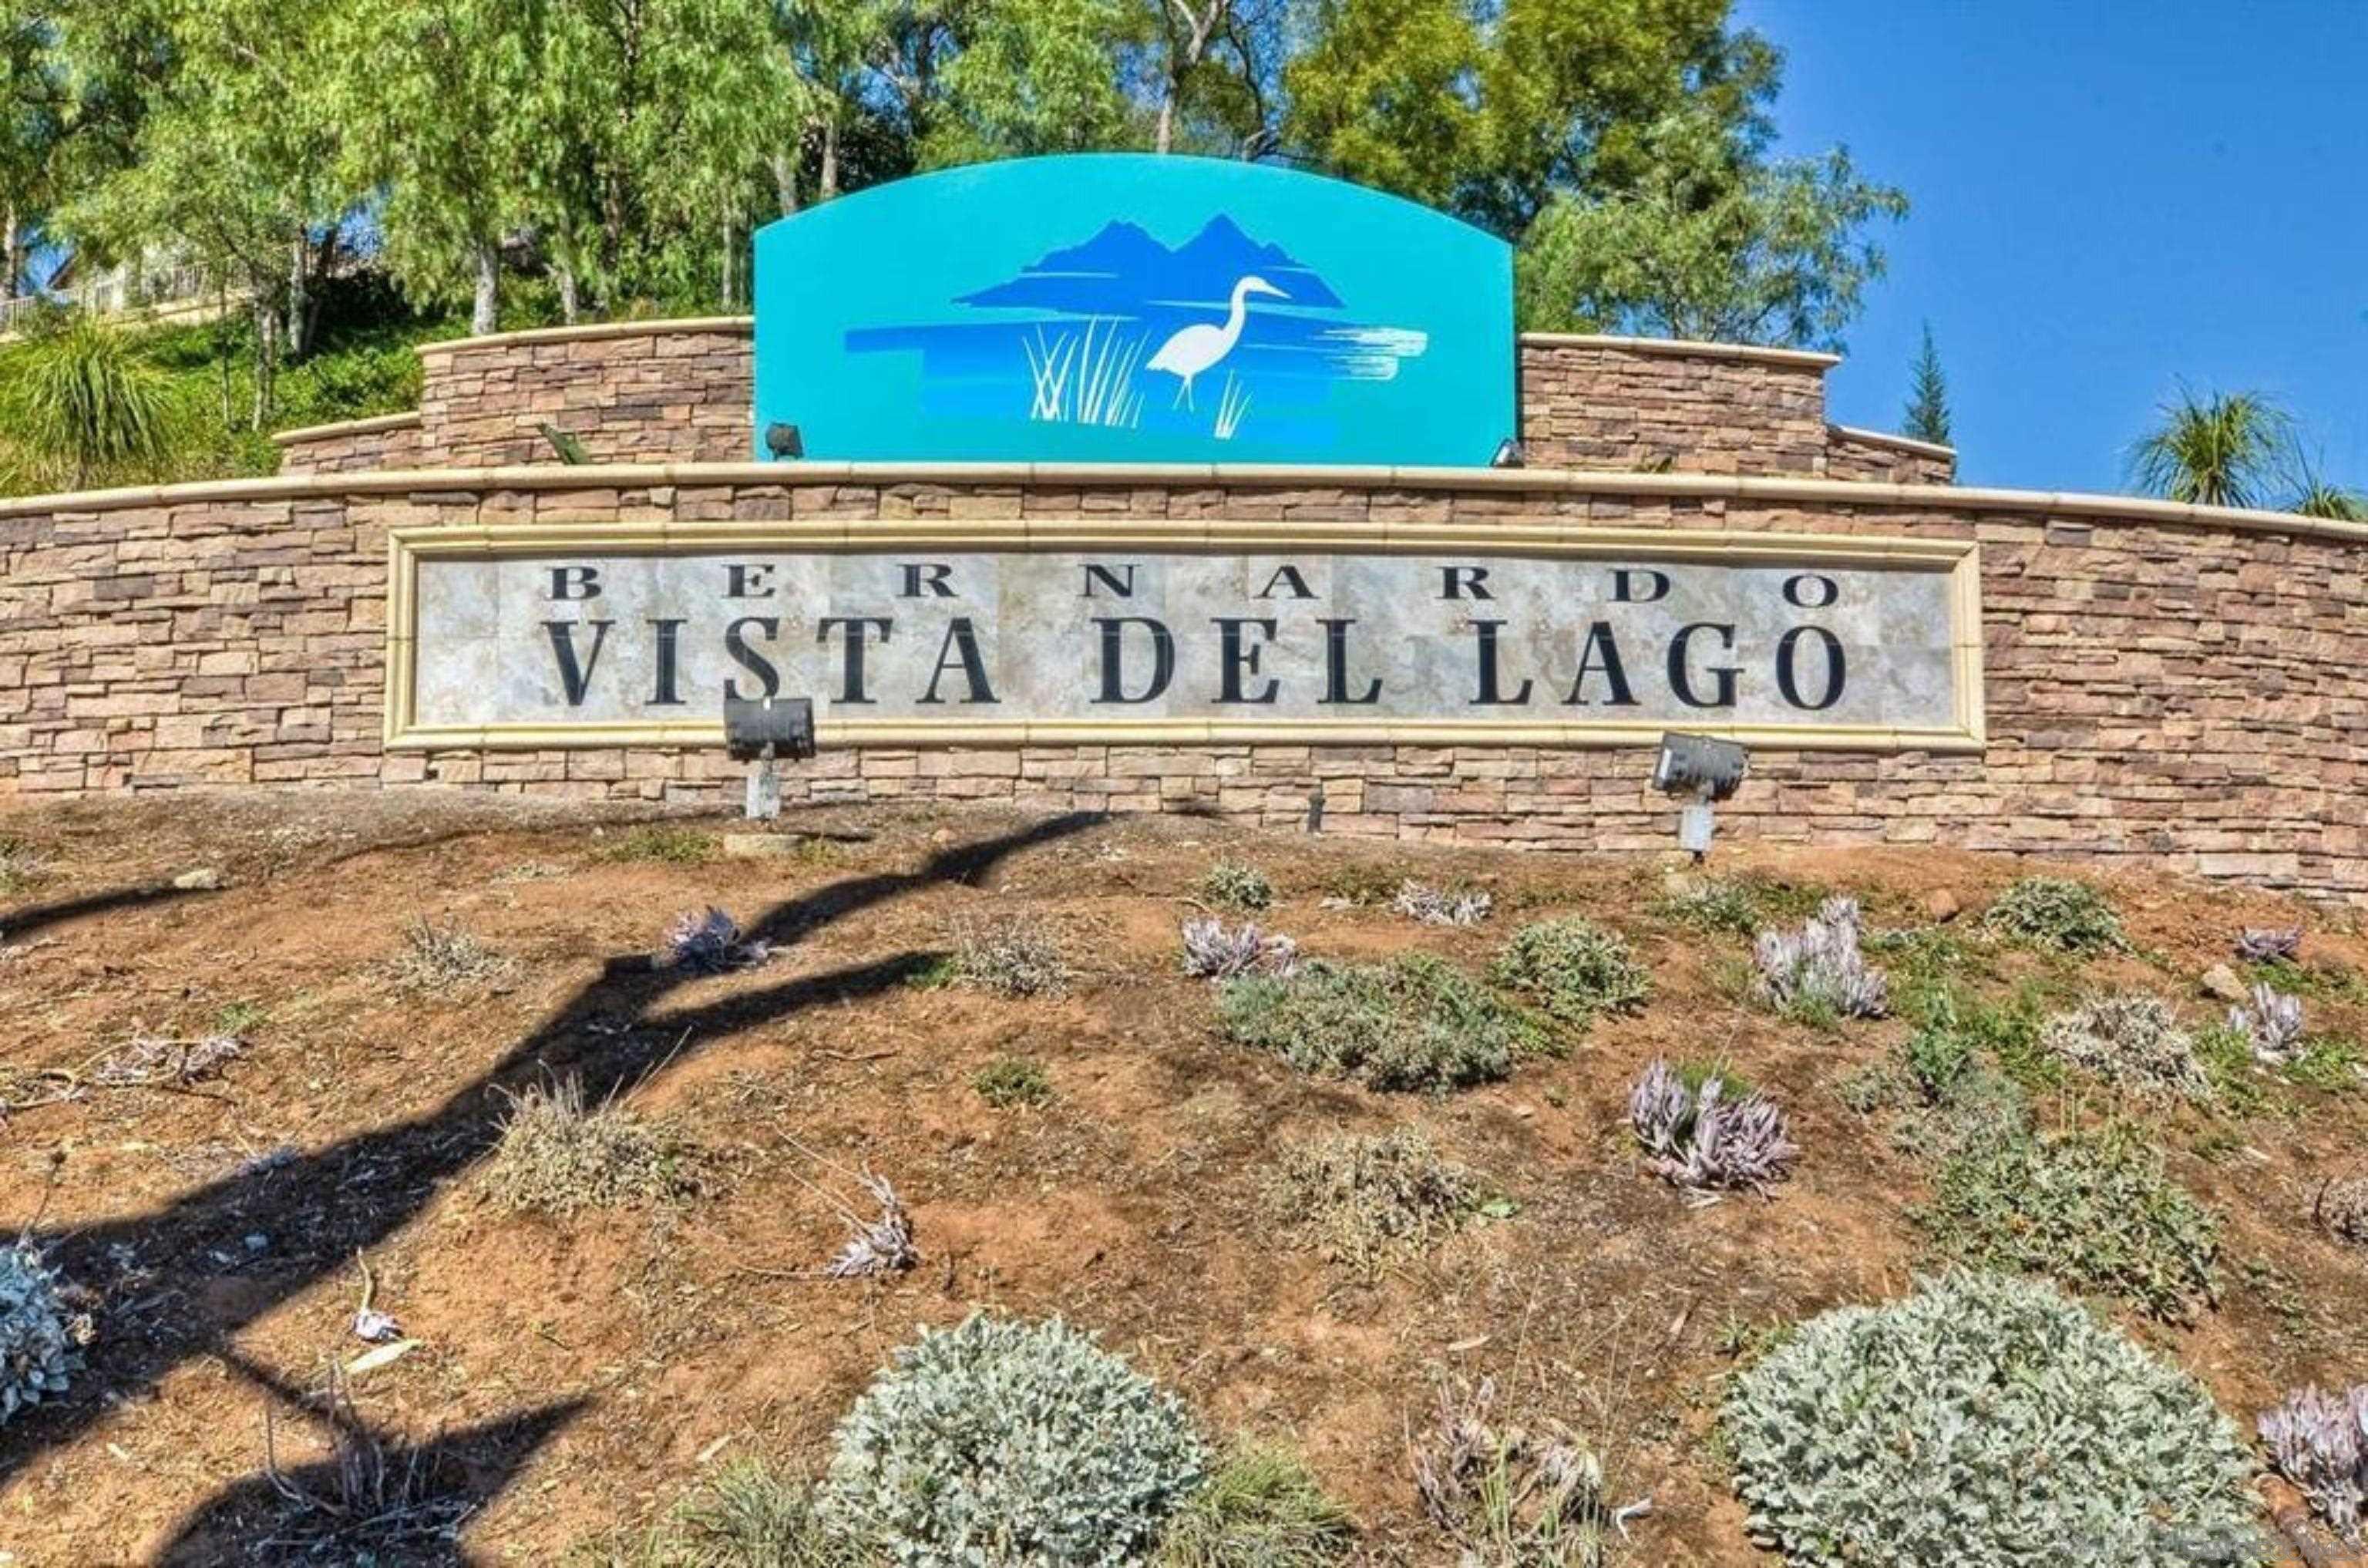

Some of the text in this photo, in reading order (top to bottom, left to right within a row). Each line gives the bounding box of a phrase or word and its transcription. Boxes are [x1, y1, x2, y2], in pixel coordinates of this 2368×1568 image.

[544, 564, 1840, 607] BERNARDO
[540, 617, 1847, 710] VISTA DEL LAGO
